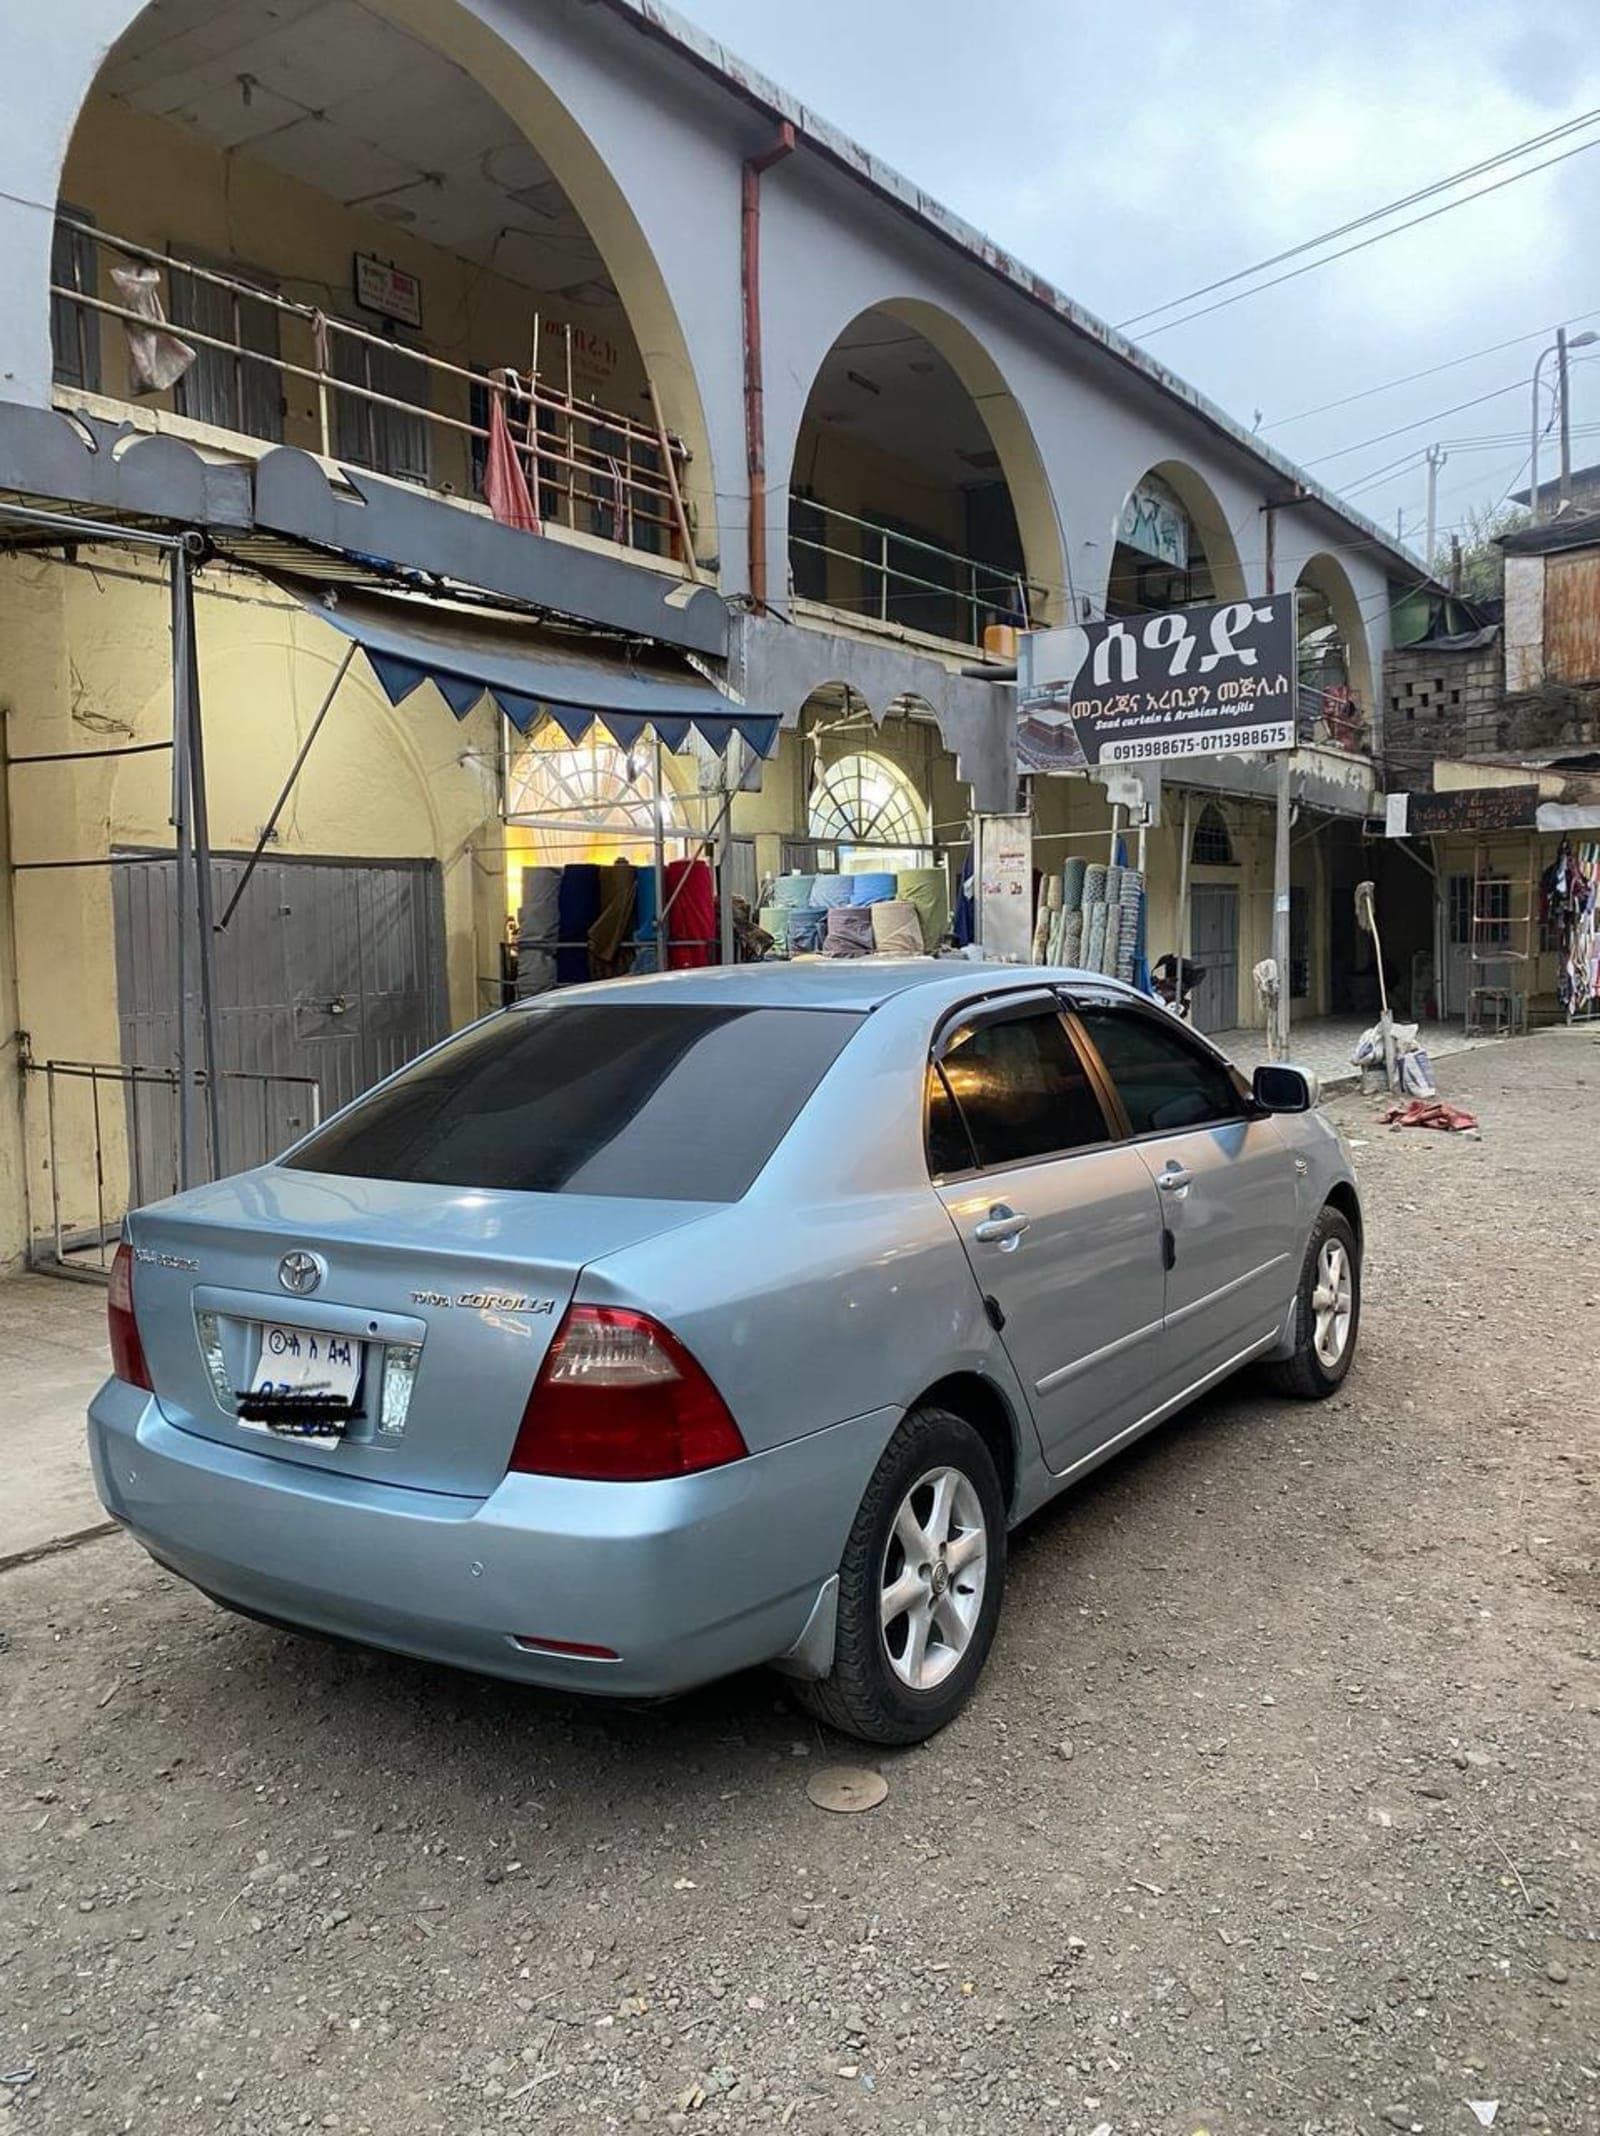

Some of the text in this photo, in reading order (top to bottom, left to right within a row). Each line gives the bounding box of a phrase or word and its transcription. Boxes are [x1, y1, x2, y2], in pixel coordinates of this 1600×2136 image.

[1094, 603, 1274, 686] ሰዓድ
[1072, 674, 1288, 719] መጋረጃና አረቢያን መጅሊስ
[1121, 713, 1162, 727] curtain
[1163, 712, 1172, 722] &
[1174, 706, 1218, 721] Arabian
[1220, 700, 1254, 716] Majlis
[1114, 728, 1286, 760] 0913988675-0713988675
[457, 1292, 555, 1314] COROLLA
